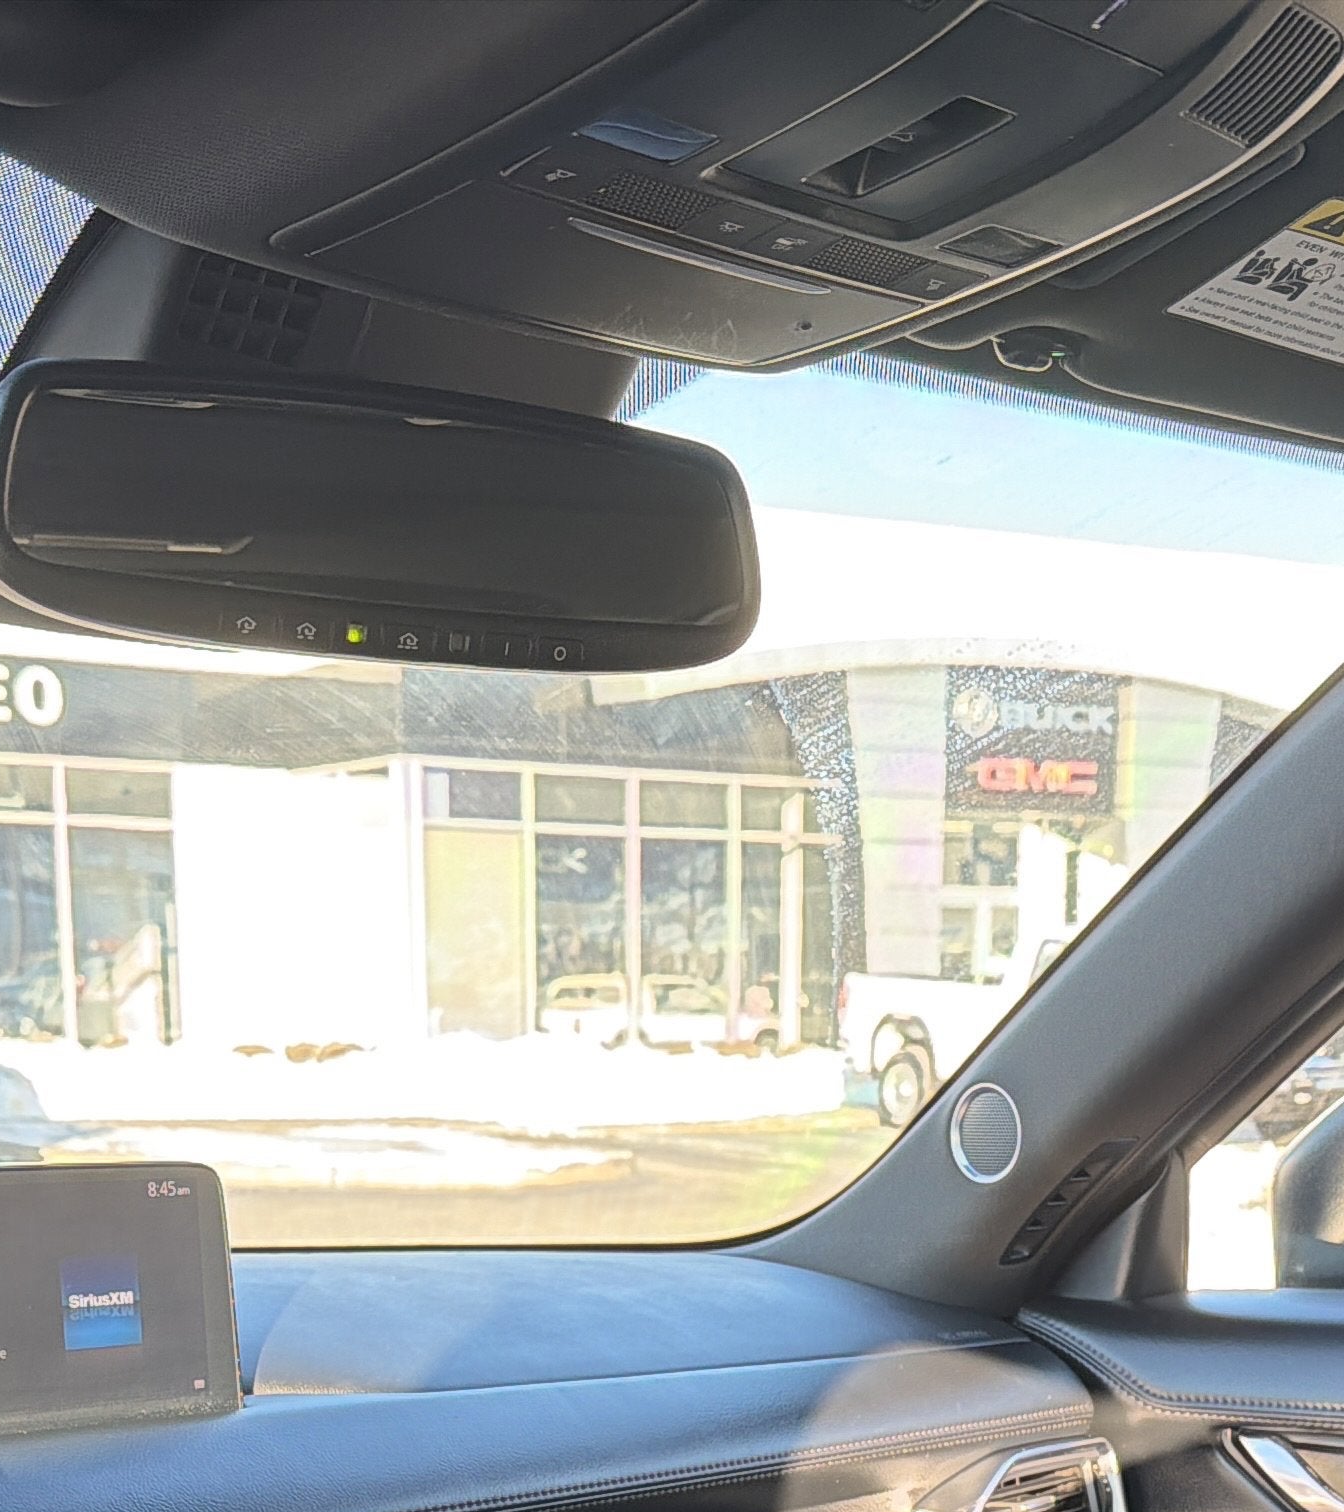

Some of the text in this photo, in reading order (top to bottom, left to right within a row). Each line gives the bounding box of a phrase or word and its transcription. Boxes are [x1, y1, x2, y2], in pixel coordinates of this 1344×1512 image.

[1295, 240, 1327, 253] EVEN
[976, 756, 1099, 795] GMC
[147, 1180, 191, 1198] 8:45 am
[68, 1291, 134, 1309] SiriusXM
